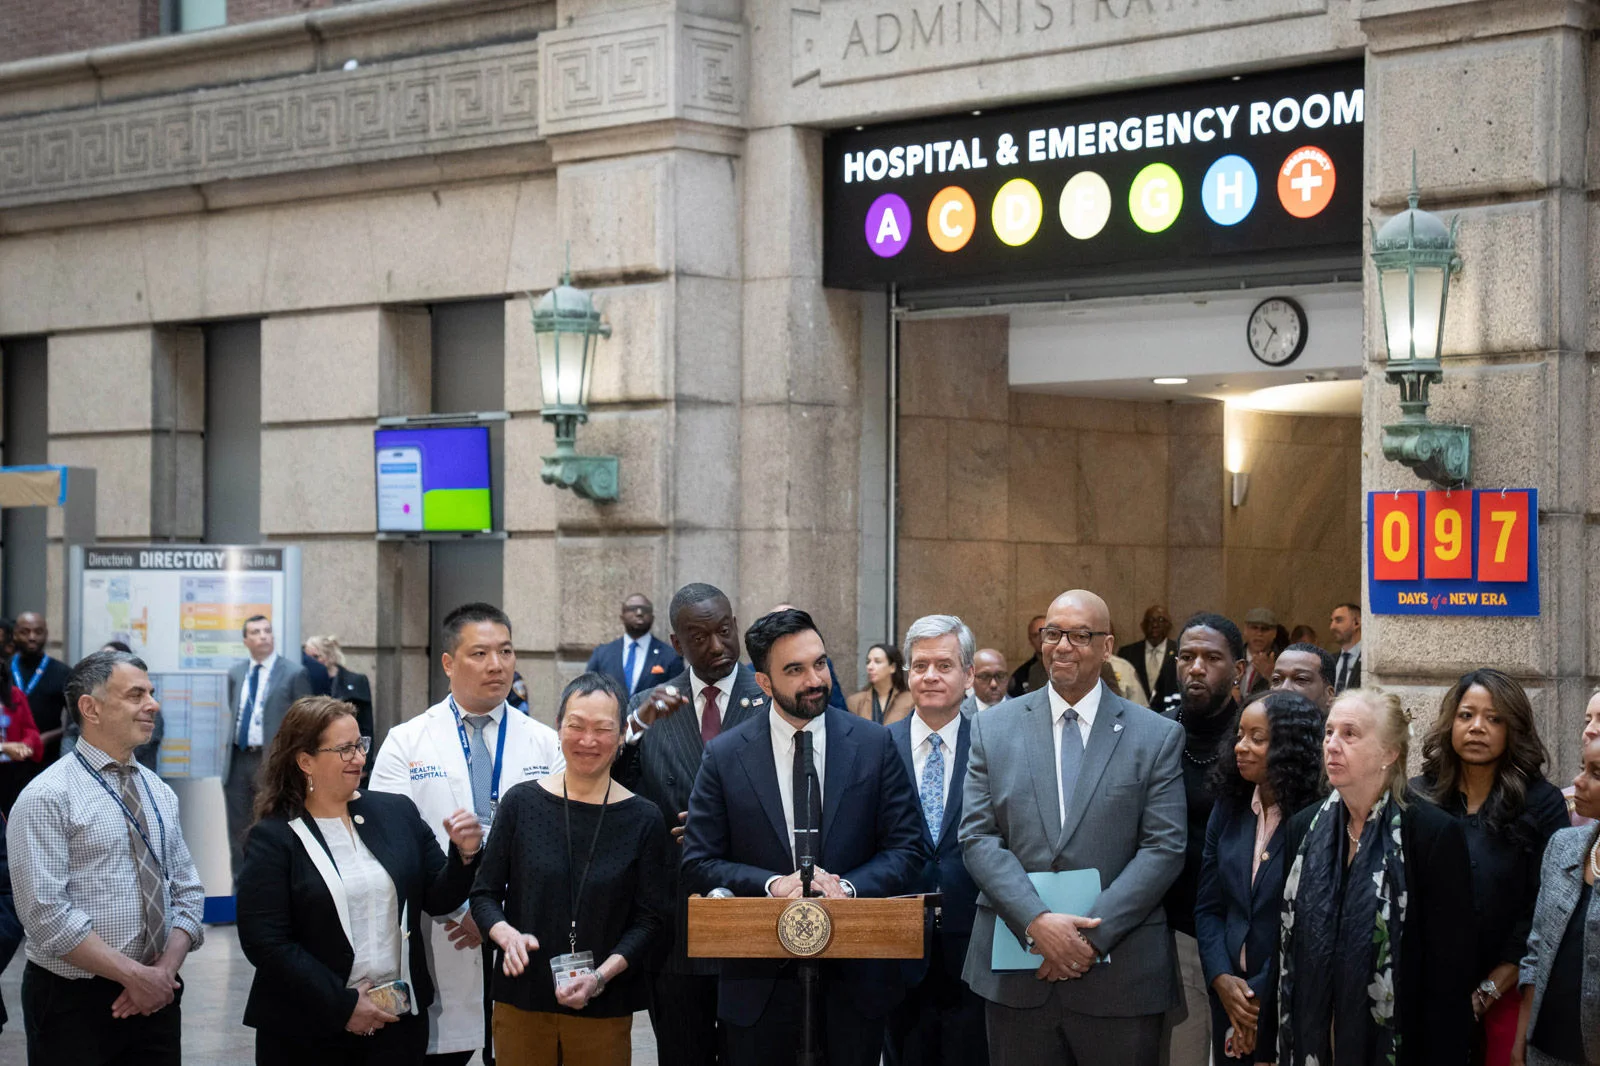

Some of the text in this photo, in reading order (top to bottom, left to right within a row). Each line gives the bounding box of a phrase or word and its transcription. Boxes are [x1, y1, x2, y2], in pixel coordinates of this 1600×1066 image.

[844, 88, 1365, 184] HOSPITAL & EMERGENCY ROOM
[875, 172, 1243, 244] A C D F G H
[89, 552, 133, 567] Directorio
[139, 551, 225, 569] DIRECTORY
[1398, 592, 1429, 605] DAYS
[1449, 593, 1478, 605] NEW
[1481, 593, 1508, 605] ERA
[409, 766, 436, 774] HEALTH
